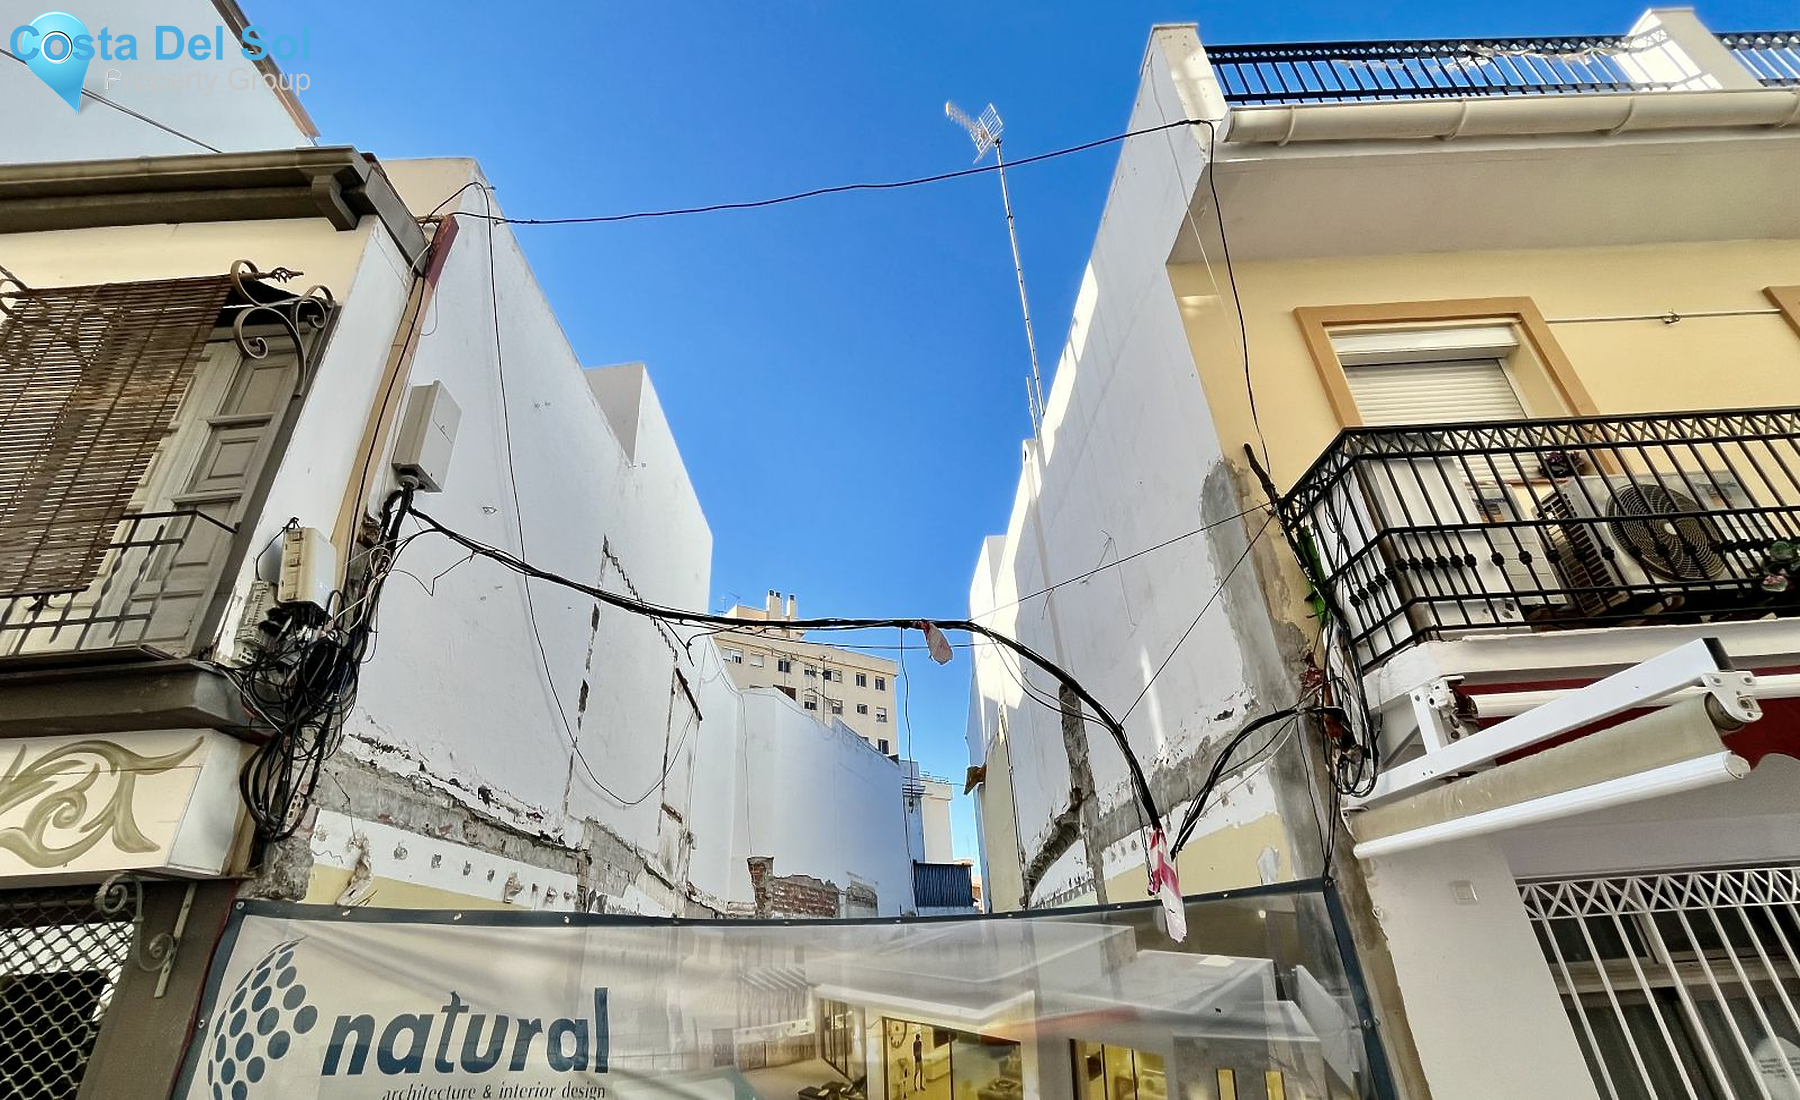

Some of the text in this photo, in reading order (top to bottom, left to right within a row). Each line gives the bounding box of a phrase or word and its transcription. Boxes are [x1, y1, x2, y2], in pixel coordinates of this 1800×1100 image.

[320, 987, 611, 1076] natural
[381, 1080, 606, 1100] architecture & interior design
